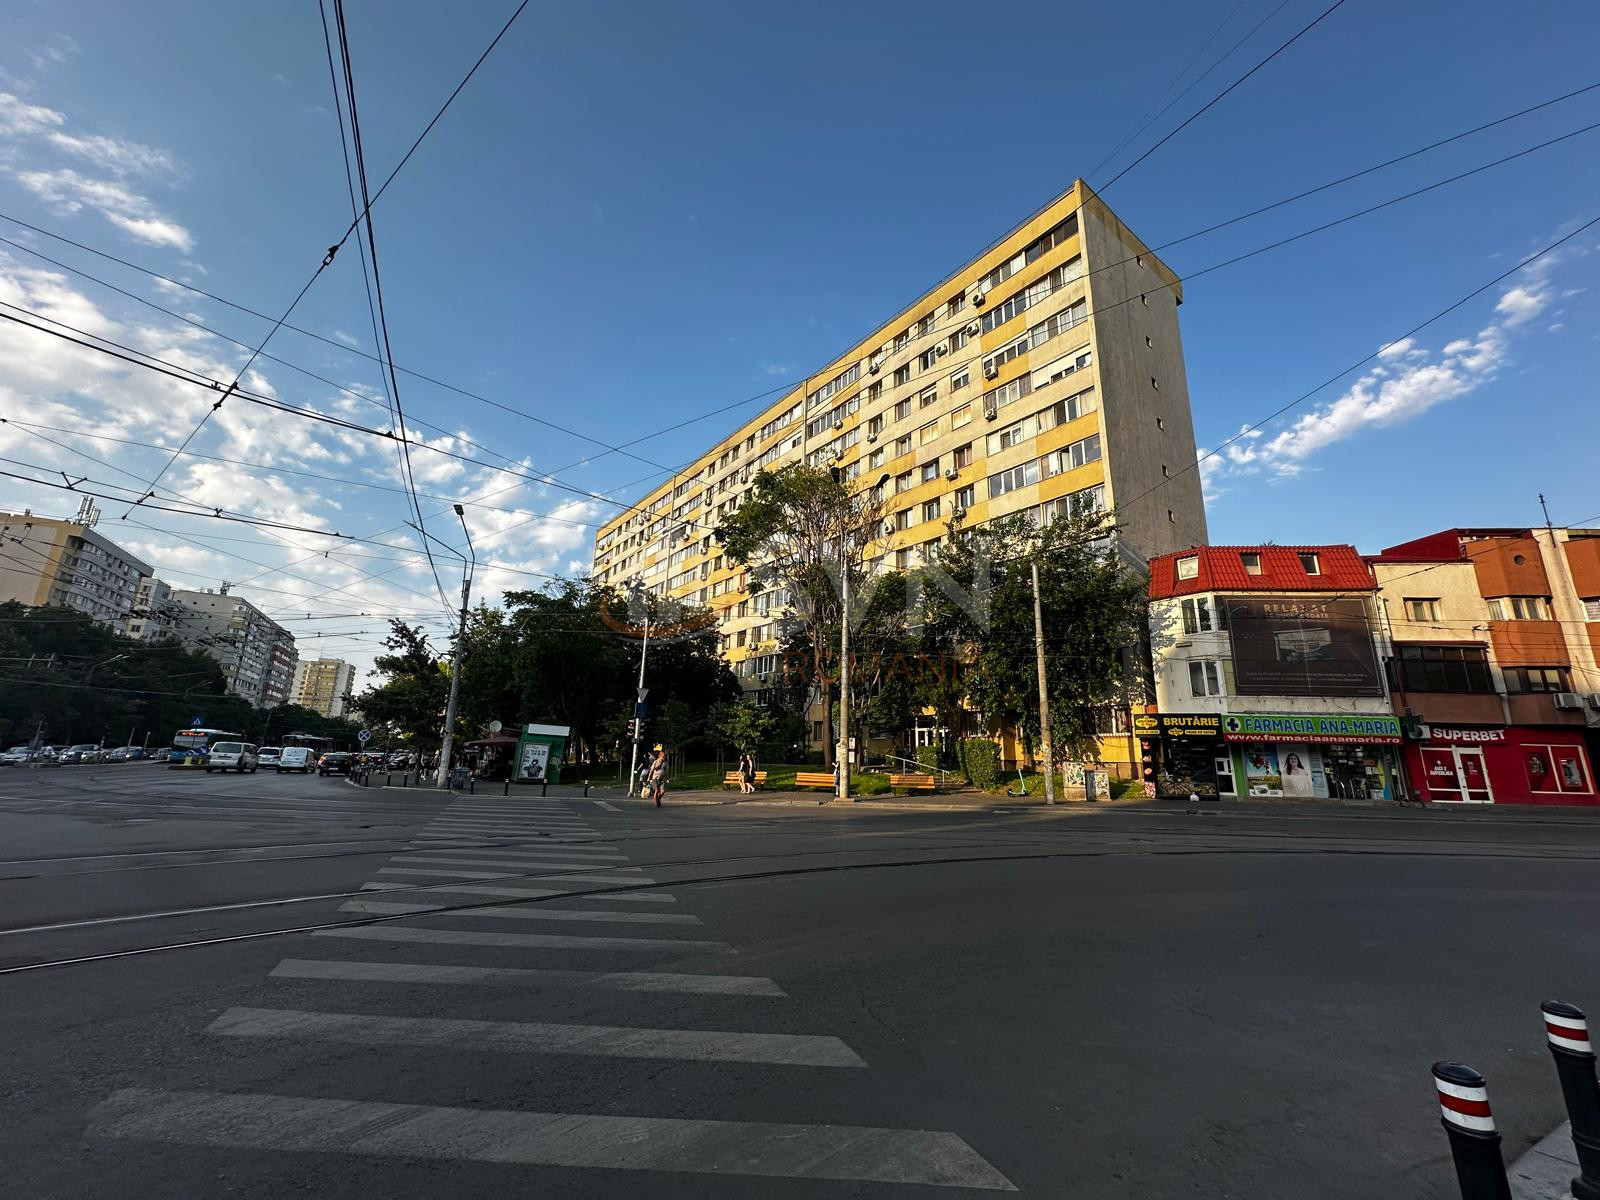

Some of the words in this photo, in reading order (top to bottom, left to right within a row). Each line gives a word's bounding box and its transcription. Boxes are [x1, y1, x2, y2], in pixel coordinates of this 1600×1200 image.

[1244, 718, 1315, 733] FARMACIA
[1319, 719, 1399, 735] ANA-MARIA
[1227, 734, 1400, 744] www.farmaciaanamaria.ro
[1432, 728, 1505, 741] SUPERBET
